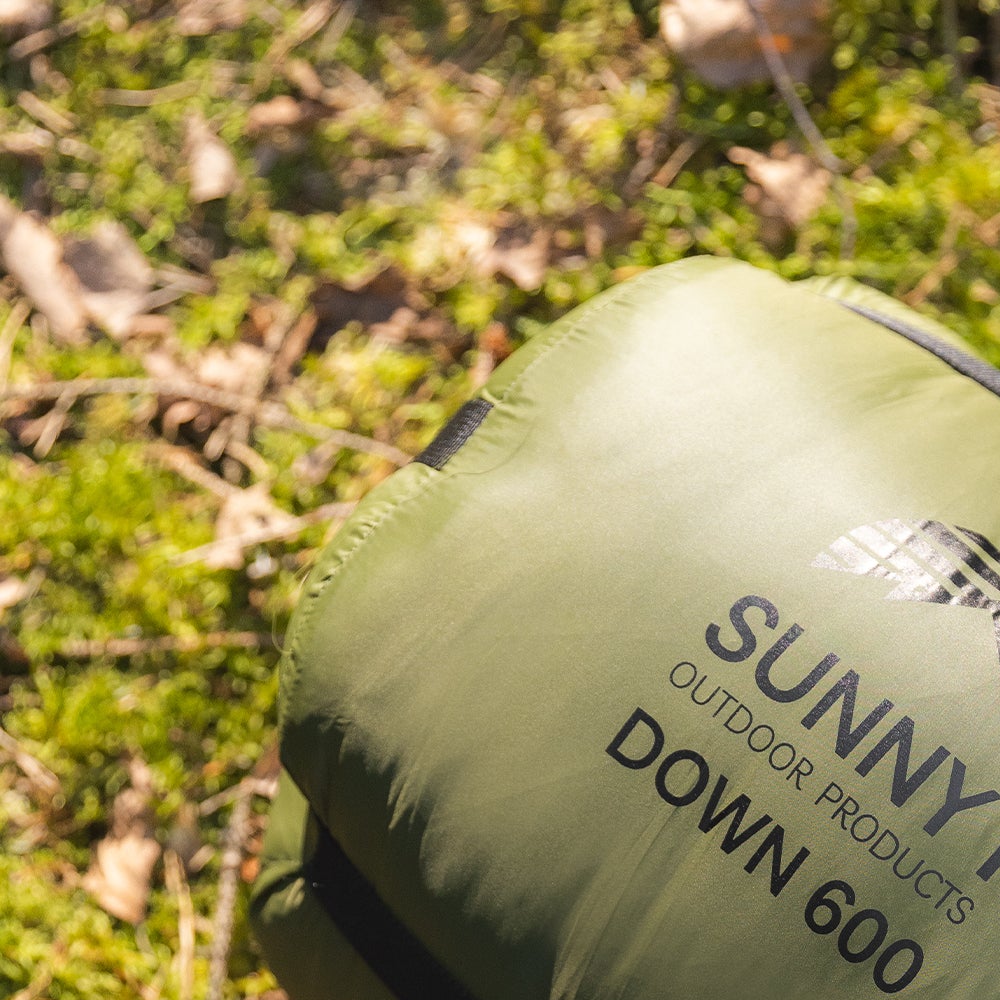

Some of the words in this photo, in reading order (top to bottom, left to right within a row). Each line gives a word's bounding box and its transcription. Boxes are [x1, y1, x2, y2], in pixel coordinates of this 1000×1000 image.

[605, 706, 811, 898] DOWN
[803, 879, 924, 994] 600
[668, 661, 814, 791] OUTDOOR
[814, 781, 975, 926] PRODUCTS
